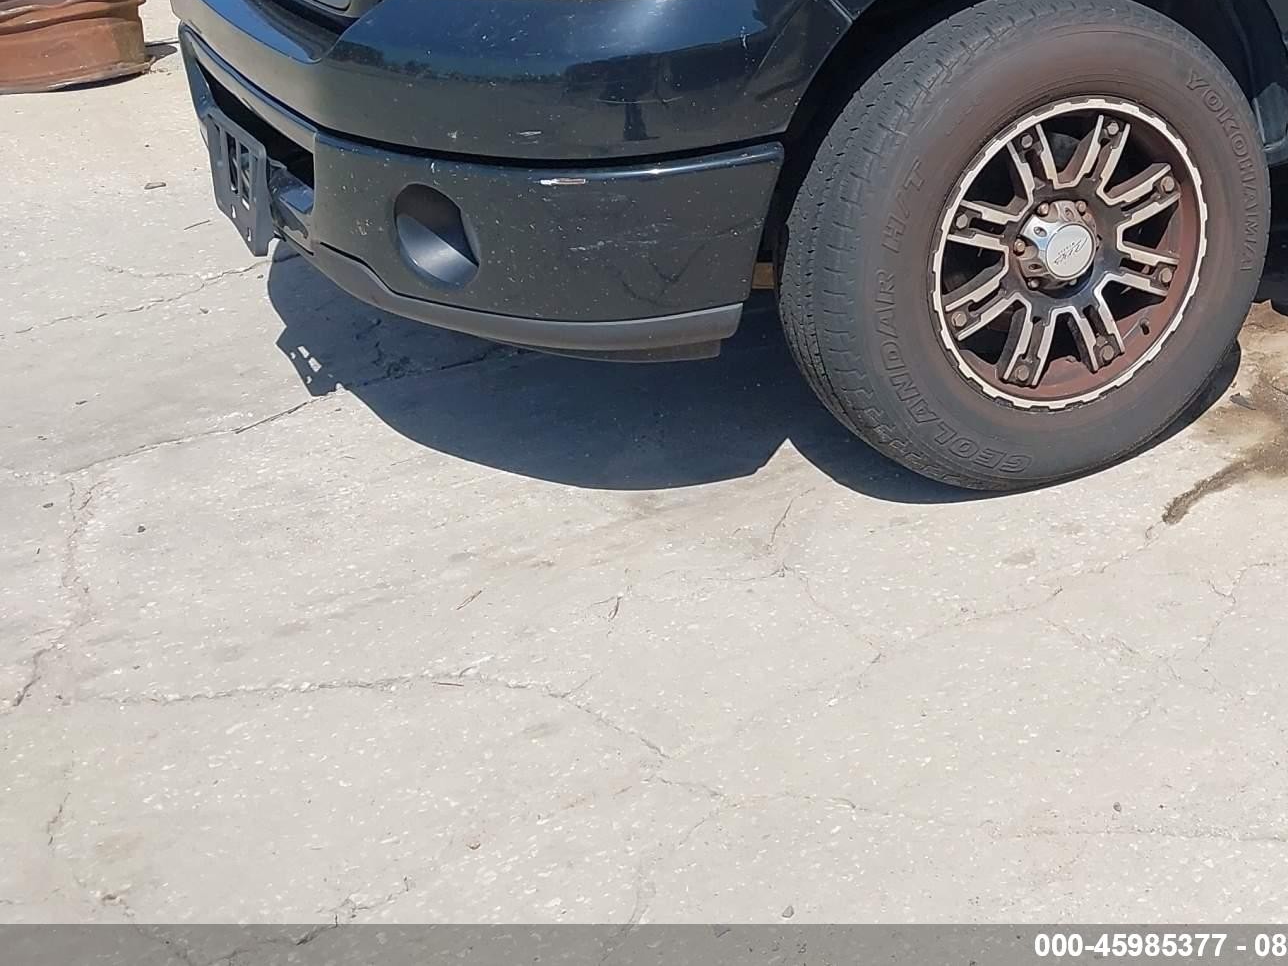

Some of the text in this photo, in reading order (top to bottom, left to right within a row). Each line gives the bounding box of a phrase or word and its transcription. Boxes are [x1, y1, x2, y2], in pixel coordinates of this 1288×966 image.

[1187, 69, 1258, 271] YOKOHAMA
[876, 158, 1033, 473] GEOLANDAR H/T
